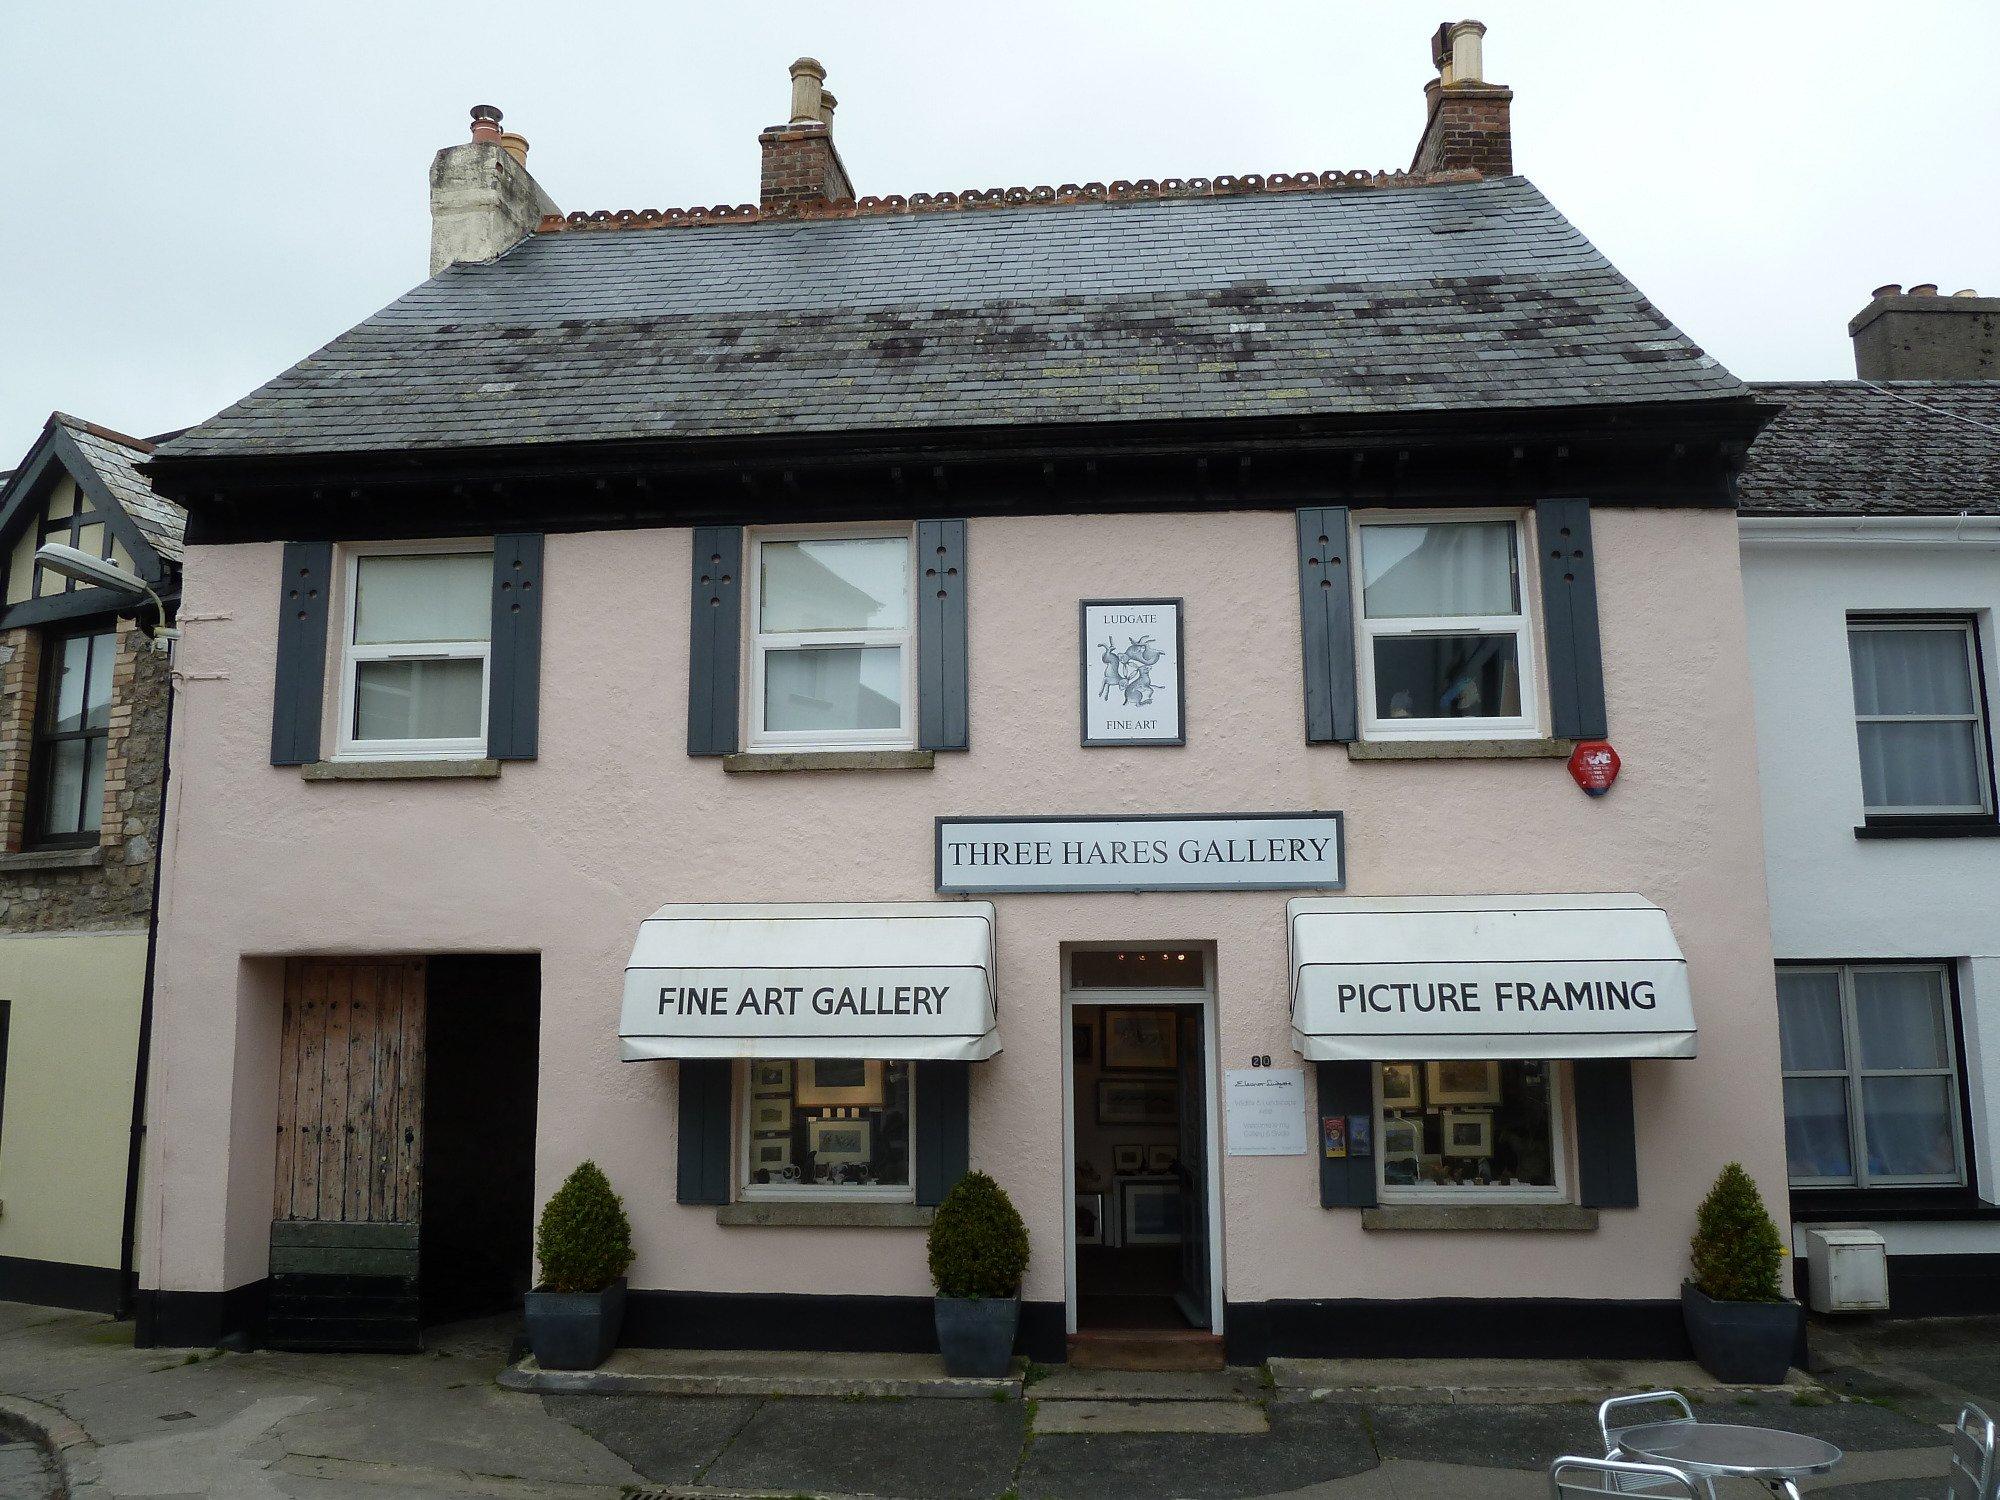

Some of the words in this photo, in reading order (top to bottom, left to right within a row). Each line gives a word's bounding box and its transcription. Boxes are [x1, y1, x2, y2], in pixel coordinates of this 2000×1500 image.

[1104, 614, 1157, 624] LUDGATE
[1106, 720, 1132, 730] FINE
[1134, 719, 1158, 730] ART
[948, 841, 1053, 866] THREE
[1061, 840, 1169, 865] HARES
[1178, 837, 1332, 864] GALLERY
[658, 987, 728, 1016] FINE
[735, 987, 804, 1016] ART
[811, 986, 950, 1016] GALLERY
[1337, 982, 1481, 1013] PICTURE
[1494, 980, 1656, 1012] FRAMING
[1252, 1056, 1271, 1066] 20
